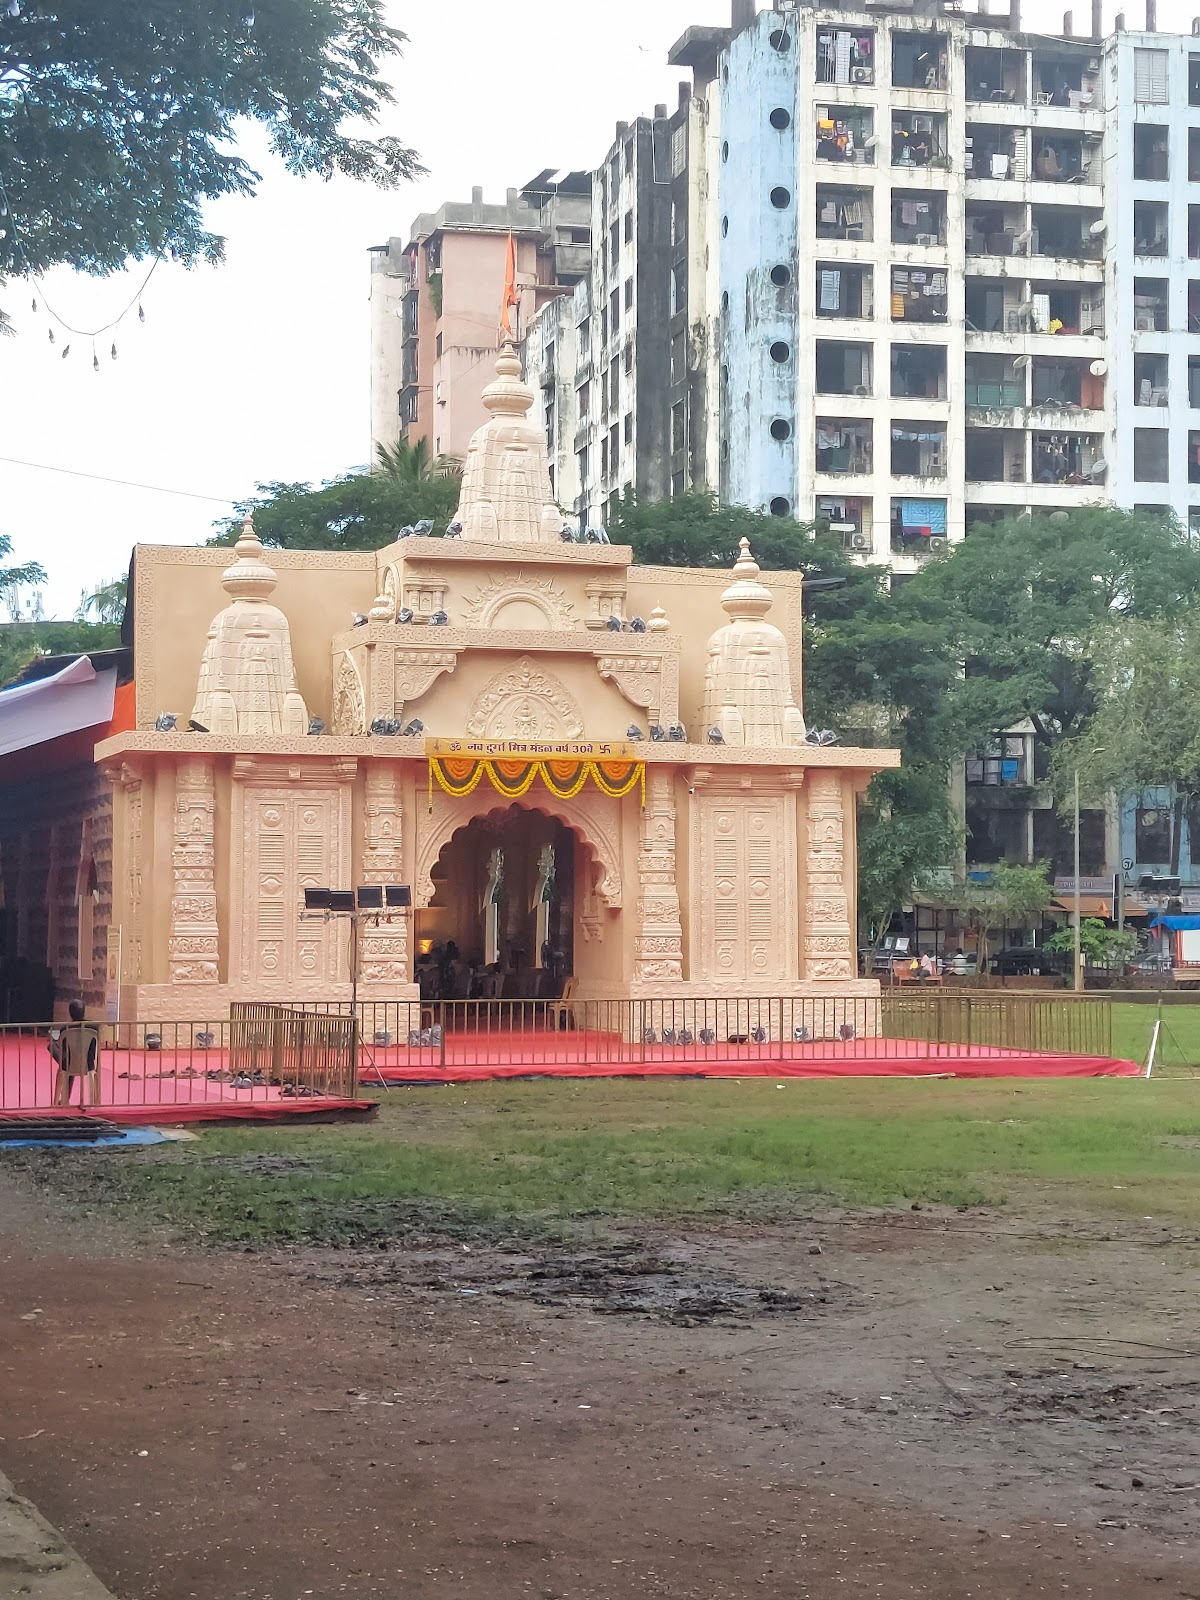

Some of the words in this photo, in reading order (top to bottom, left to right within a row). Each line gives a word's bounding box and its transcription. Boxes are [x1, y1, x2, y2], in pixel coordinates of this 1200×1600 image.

[467, 743, 483, 751] नव
[486, 742, 506, 754] दुर्गा
[509, 741, 527, 752] मित्र
[555, 743, 569, 752] वर्ष
[1122, 859, 1132, 869] 67
